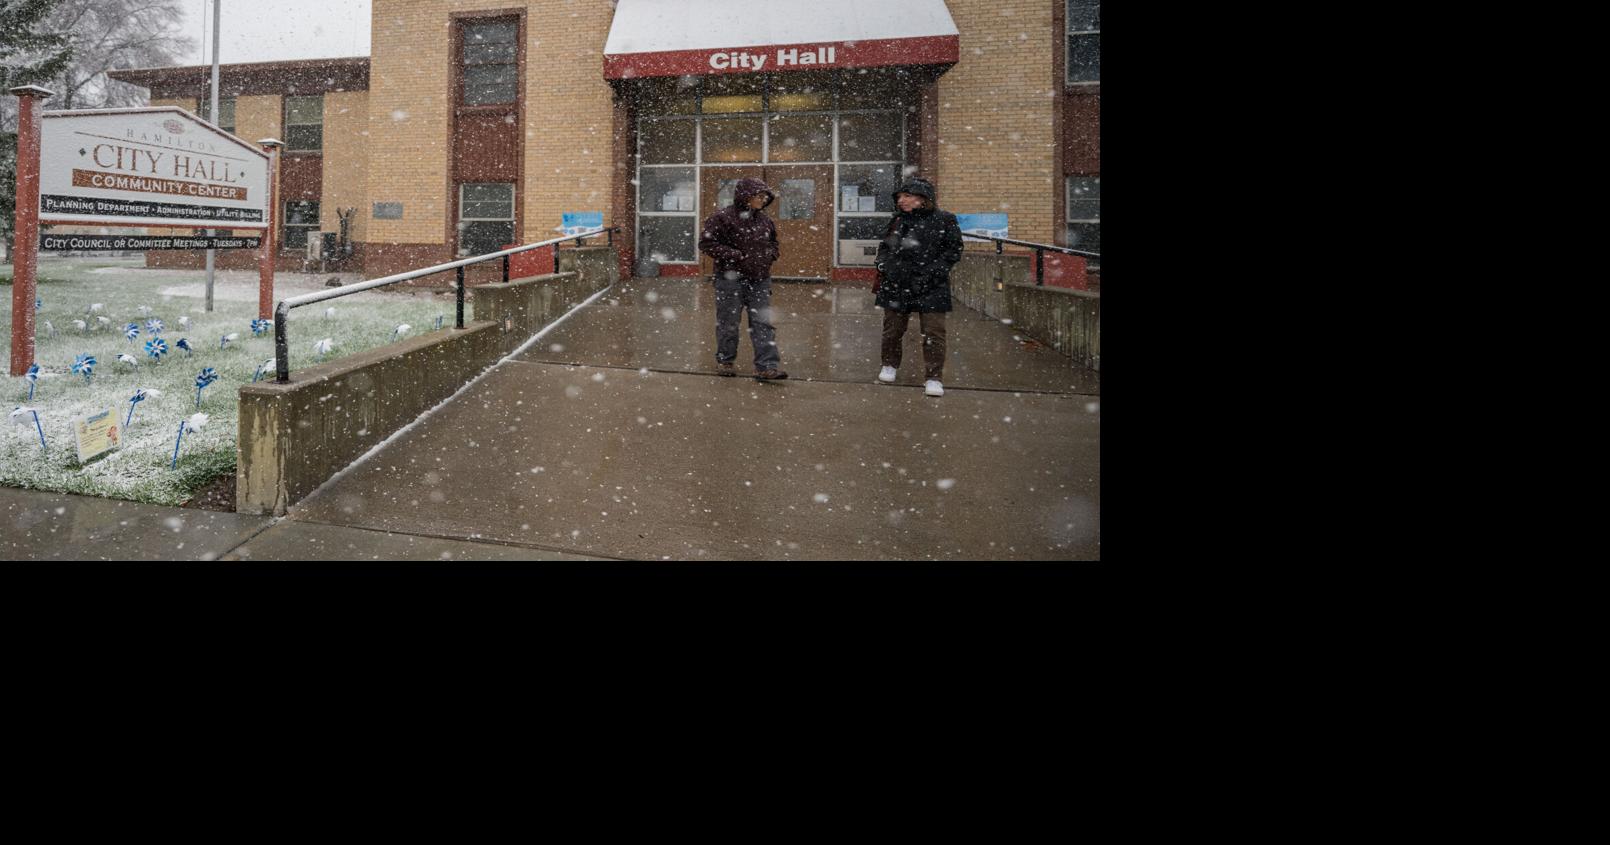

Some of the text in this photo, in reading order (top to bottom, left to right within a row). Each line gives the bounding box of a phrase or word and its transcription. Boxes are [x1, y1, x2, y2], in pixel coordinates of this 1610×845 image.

[709, 47, 835, 71] City Hall
[127, 128, 216, 152] HAMILTON
[93, 144, 236, 183] CITY HALL
[92, 175, 237, 198] COMMUNITY CENTER
[46, 199, 94, 210] PLANNING
[97, 202, 150, 213] DEPARTMENT
[157, 206, 211, 216] ADMINISTRATION
[216, 208, 239, 217] UTILITY
[44, 238, 69, 248] CITY
[70, 238, 112, 249] COUNCIL
[114, 239, 125, 248] OR
[127, 239, 172, 248] COMMITTEE
[173, 239, 208, 249] MEETINGS
[213, 240, 243, 248] TUESDAYS
